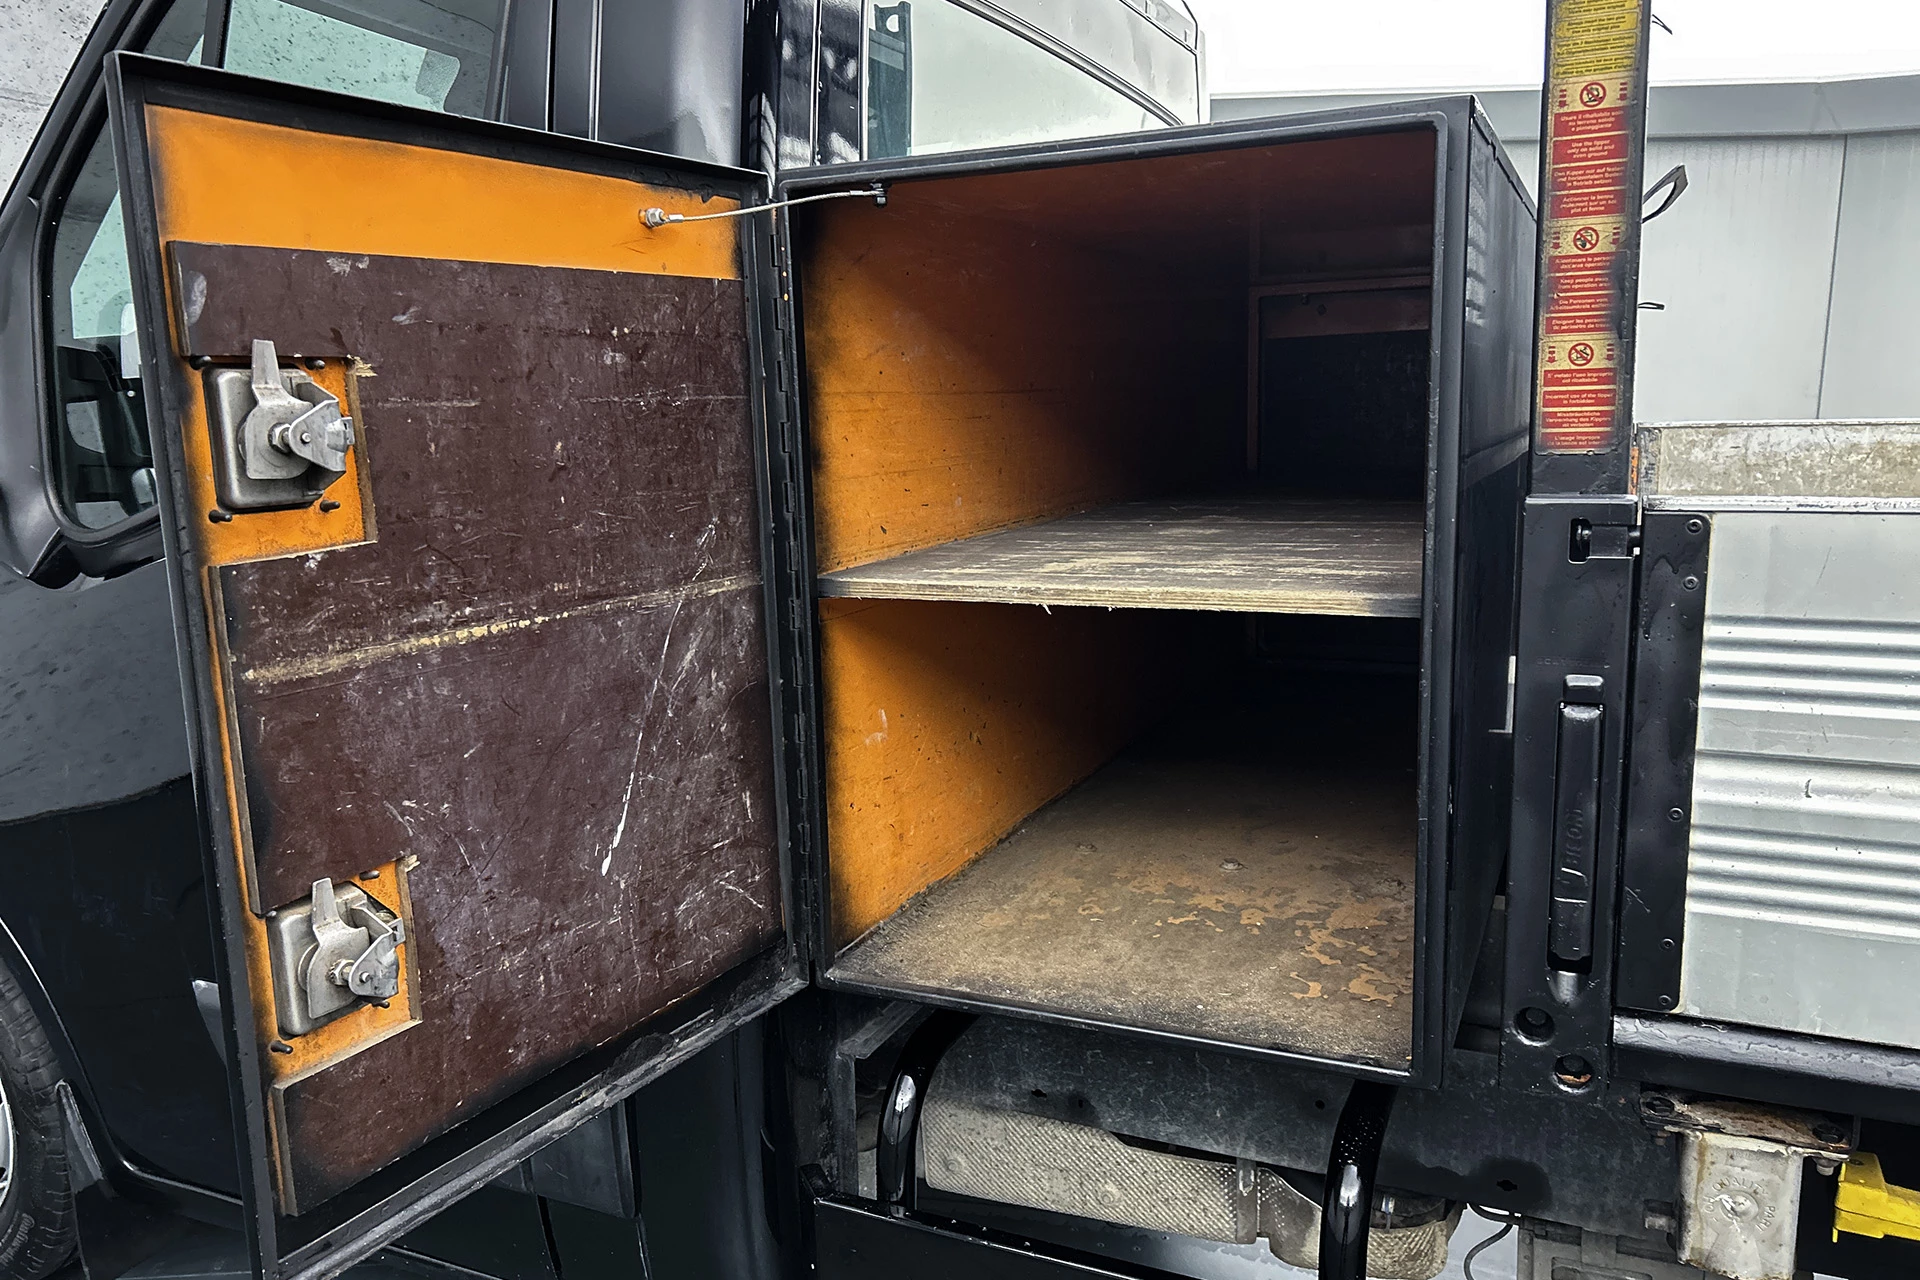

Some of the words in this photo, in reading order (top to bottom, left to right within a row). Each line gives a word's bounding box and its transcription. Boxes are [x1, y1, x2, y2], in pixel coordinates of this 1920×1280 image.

[1588, 150, 1608, 158] ground
[1711, 1177, 1768, 1196] QUALITY
[1756, 1205, 1776, 1232] PART
